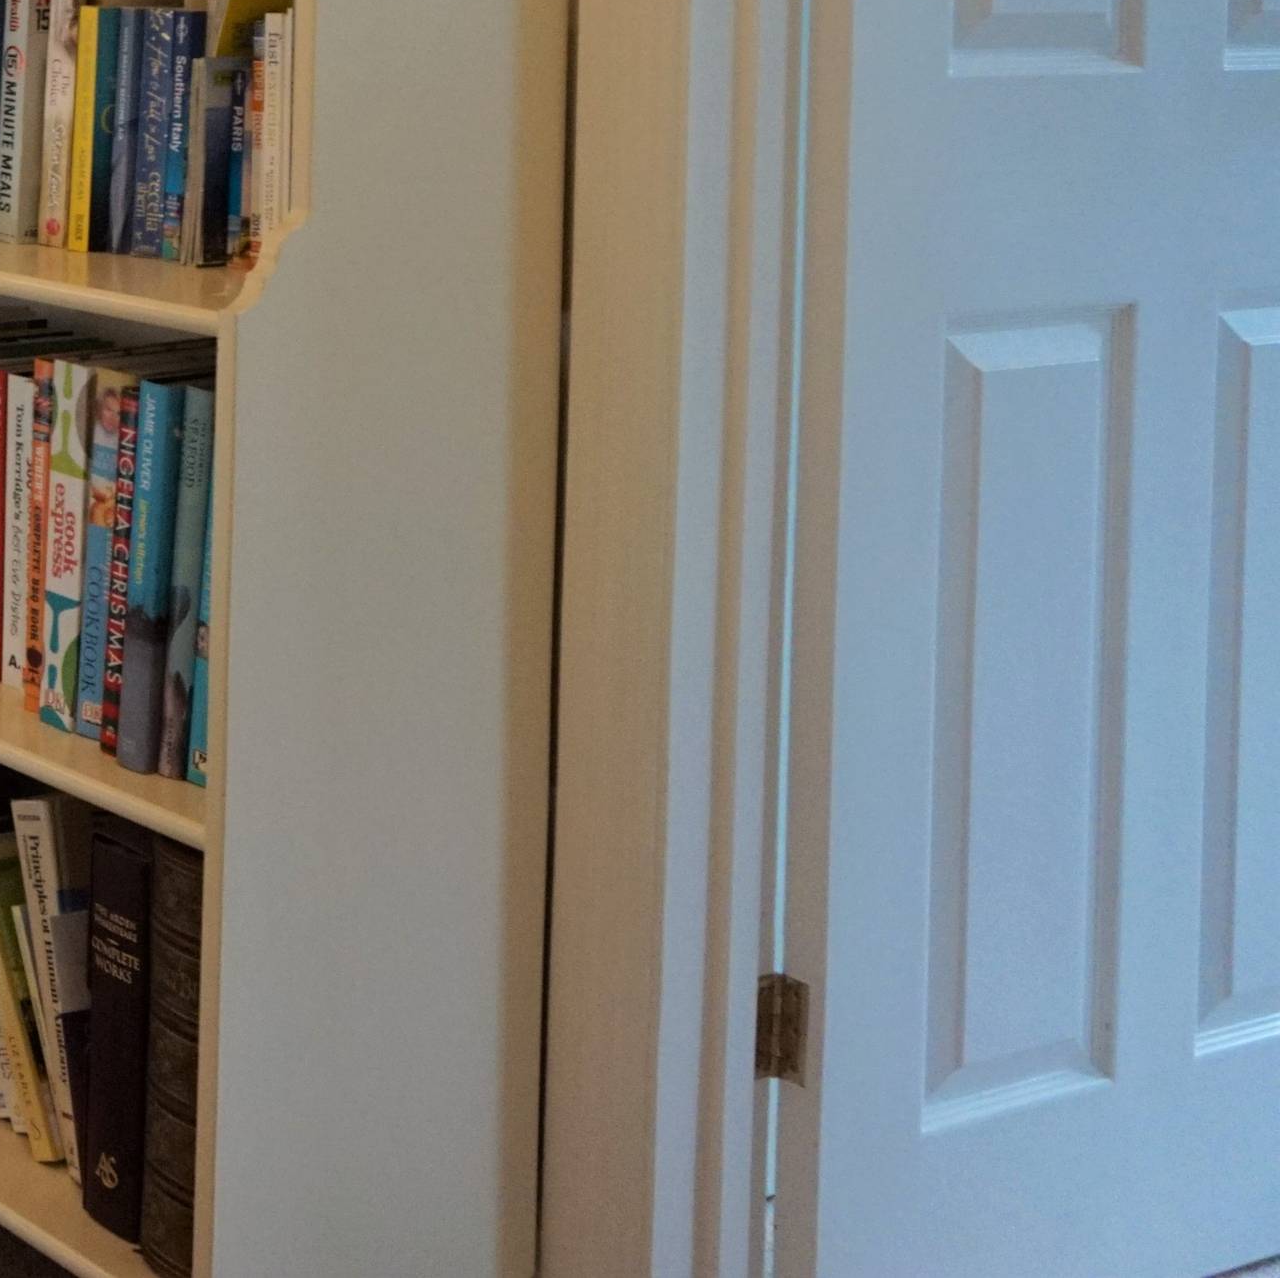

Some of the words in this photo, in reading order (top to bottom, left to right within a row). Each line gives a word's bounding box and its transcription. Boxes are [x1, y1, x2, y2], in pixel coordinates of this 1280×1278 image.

[267, 31, 282, 66] fast
[49, 57, 62, 107] Choice
[173, 55, 187, 119] Southern
[1, 80, 18, 150] MINUTE
[169, 121, 185, 153] Italy
[231, 106, 244, 151] PARIS
[252, 113, 263, 149] ROME
[134, 181, 149, 218] ahern
[145, 171, 165, 231] cecelia
[251, 212, 263, 237] 2016
[14, 403, 26, 438] Tom
[142, 393, 158, 436] JAMIE
[139, 438, 155, 491] OLIVER
[184, 416, 200, 490] SEAFOOD
[12, 441, 26, 520] Kerridge's
[114, 428, 136, 532] NIGELLA
[50, 482, 68, 579] express
[63, 509, 79, 575] cook
[105, 542, 131, 684] CHRISTMAS
[26, 834, 50, 916] Principles
[43, 938, 59, 1006] Human
[91, 935, 141, 972] COMPLETE
[94, 952, 133, 985] WORKS
